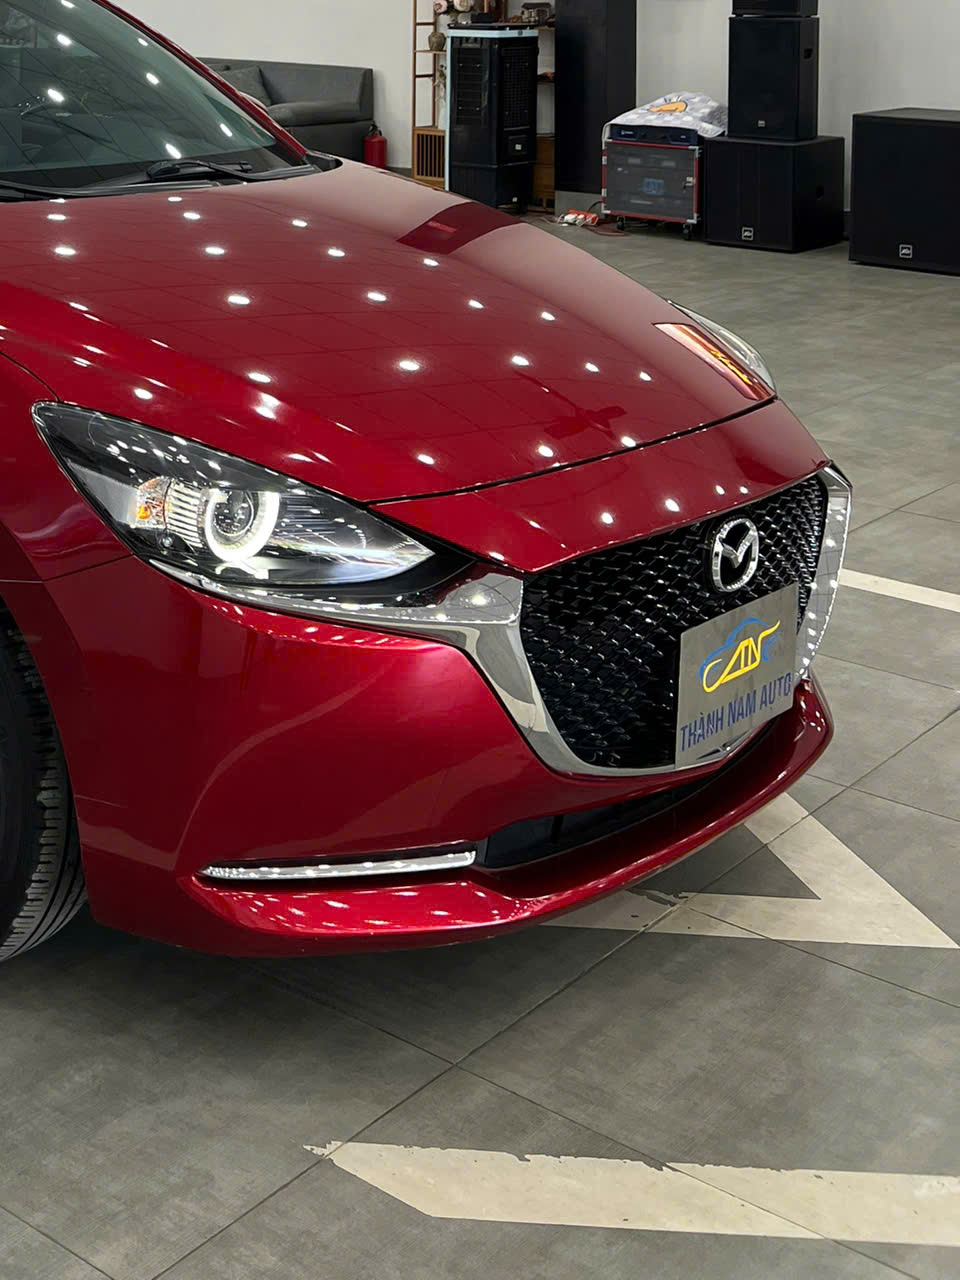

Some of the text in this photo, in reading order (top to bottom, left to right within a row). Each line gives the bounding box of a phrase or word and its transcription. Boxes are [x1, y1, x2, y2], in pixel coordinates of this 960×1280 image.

[680, 672, 791, 752] THÀNH NAM AUTO
